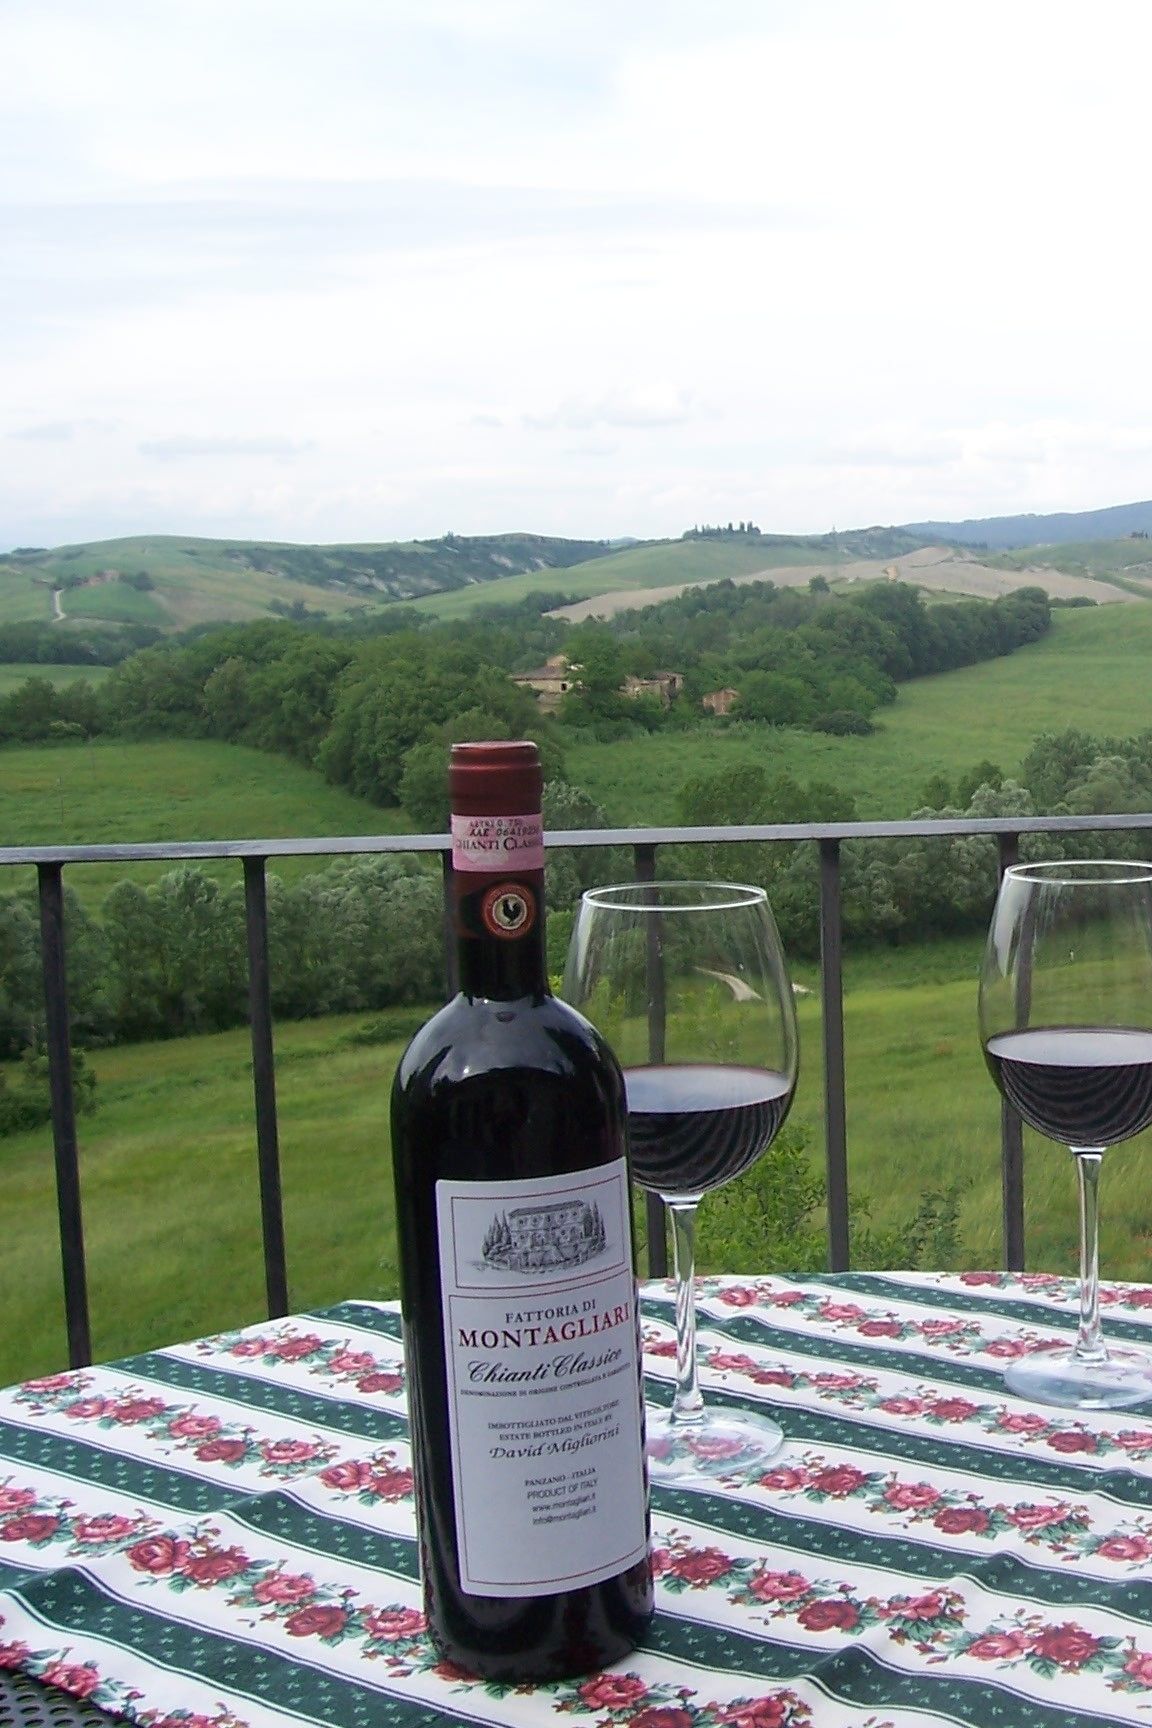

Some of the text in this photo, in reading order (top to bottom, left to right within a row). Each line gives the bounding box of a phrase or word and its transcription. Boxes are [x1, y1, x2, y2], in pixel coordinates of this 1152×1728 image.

[506, 1299, 596, 1323] FATTORIA DI
[459, 1302, 629, 1348] MONTAGLIARI
[468, 1348, 622, 1383] Chianti Classico
[488, 1417, 556, 1430] IMBOTTIGLIATO
[558, 1415, 573, 1424] DAL
[499, 1433, 531, 1441] ESTATE
[533, 1426, 572, 1439] BOTTLED
[489, 1423, 621, 1459] David Migliorini
[525, 1475, 566, 1486] PANZANO
[572, 1467, 596, 1479] ITALIA
[527, 1478, 598, 1499] PRODUCT OF ITALY
